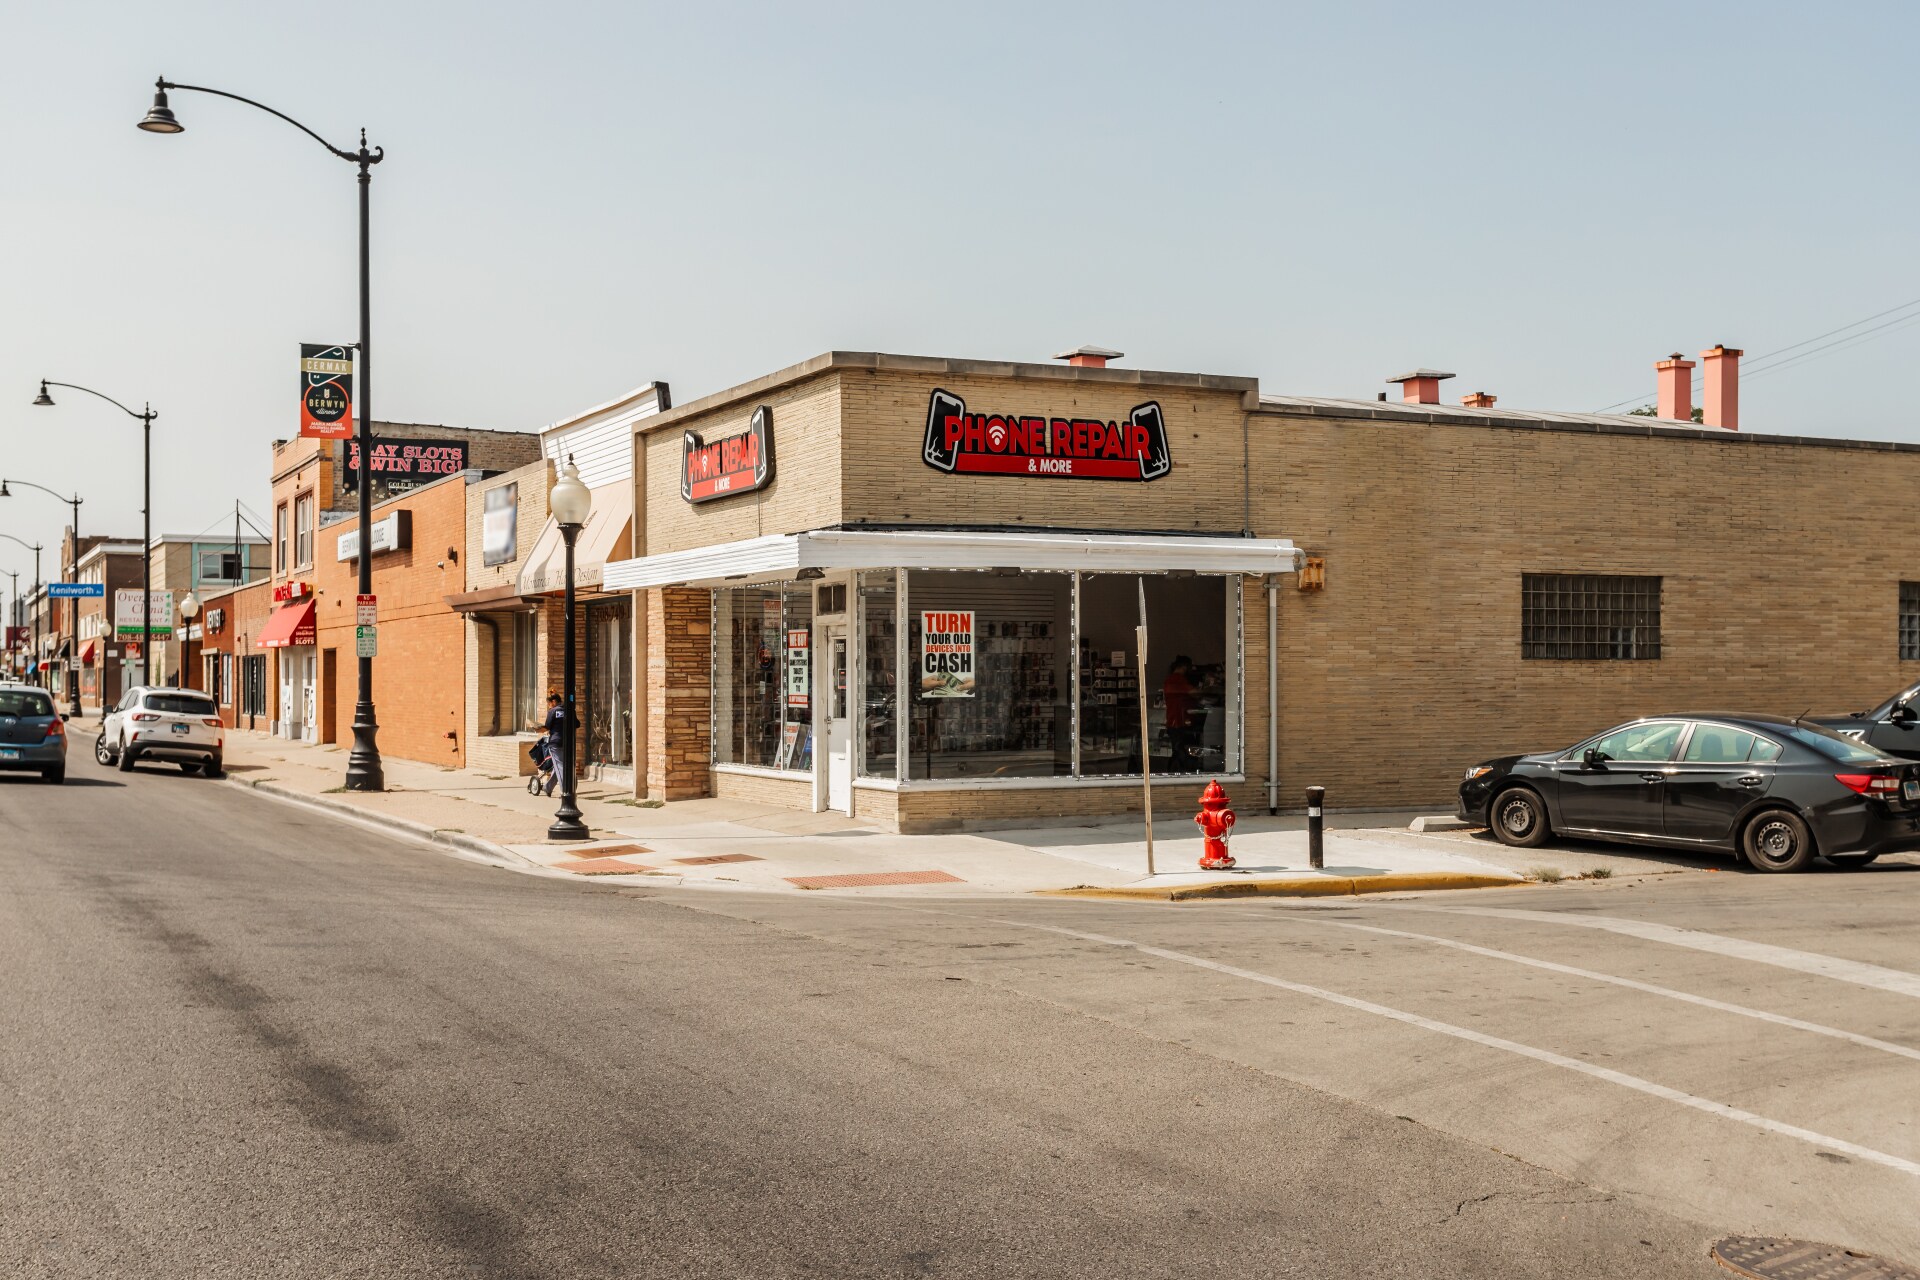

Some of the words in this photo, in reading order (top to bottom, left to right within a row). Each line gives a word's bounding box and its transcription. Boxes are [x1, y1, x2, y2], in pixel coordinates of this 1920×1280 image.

[307, 360, 347, 372] CERMAK
[309, 399, 345, 409] BERWYN
[944, 415, 1045, 454] PHONE
[1052, 420, 1151, 460] REPAIR
[403, 445, 463, 460] SLOTS
[687, 443, 721, 484] PHONE
[721, 432, 760, 475] REPAIR
[370, 456, 413, 473] WIN
[417, 458, 463, 474] BIG!
[1028, 459, 1038, 473] &
[1039, 458, 1073, 474] MORE
[718, 476, 731, 491] MORE
[574, 566, 598, 585] Design
[50, 586, 94, 595] Kenilworth
[118, 592, 164, 603] Overeas
[131, 603, 163, 614] Chna
[925, 613, 971, 633] TURN
[117, 633, 170, 641] 708-485447
[357, 628, 362, 637] 2
[789, 633, 798, 647] WE
[798, 632, 807, 647] BUY
[925, 633, 951, 645] YOUR
[953, 633, 971, 644] OLD
[926, 644, 954, 653] DEVICES
[955, 644, 971, 653] INTO
[925, 652, 972, 673] CASH
